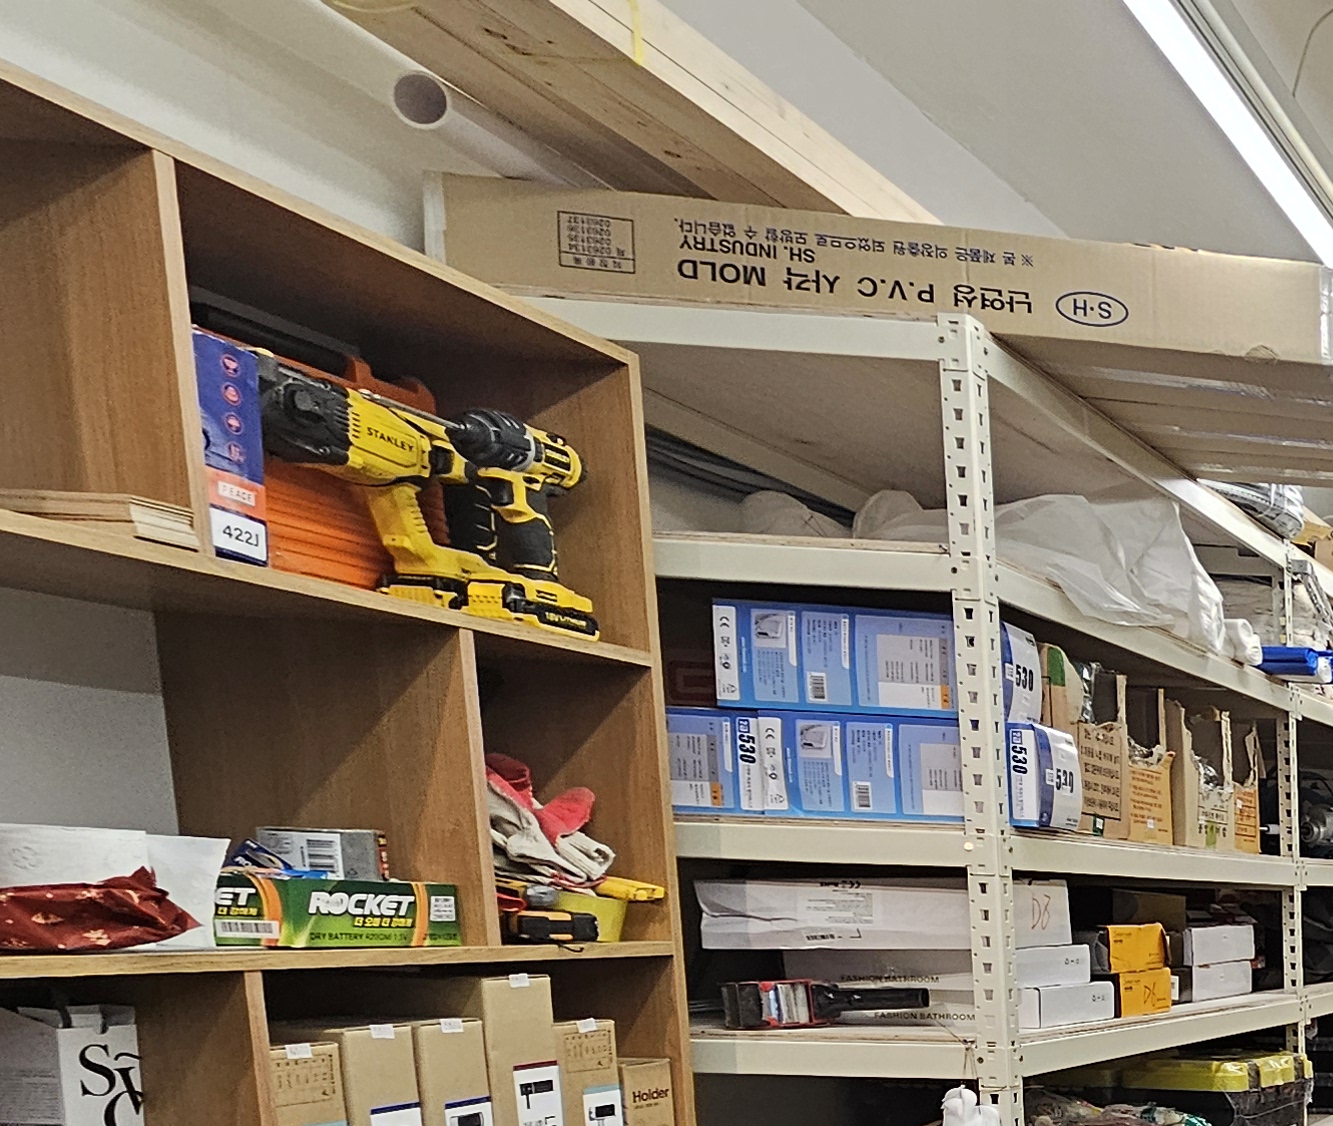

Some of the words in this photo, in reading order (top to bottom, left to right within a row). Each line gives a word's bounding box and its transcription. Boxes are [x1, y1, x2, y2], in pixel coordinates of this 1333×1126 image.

[743, 226, 758, 240] 수
[679, 235, 778, 260] INDUSTRY
[677, 259, 767, 287] MOLD
[783, 267, 840, 294] 사각
[856, 276, 935, 304] P.V.C
[953, 284, 1032, 314] 난연성
[366, 426, 415, 453] STANLEY
[1014, 664, 1035, 692] 530
[737, 730, 757, 766] 530
[1009, 743, 1028, 776] 530
[308, 891, 415, 917] ROCKET
[328, 932, 365, 941] BATTERY
[874, 1011, 918, 1021] FASHION
[919, 1012, 976, 1022] BATHROOM
[631, 1085, 670, 1105] Holder
